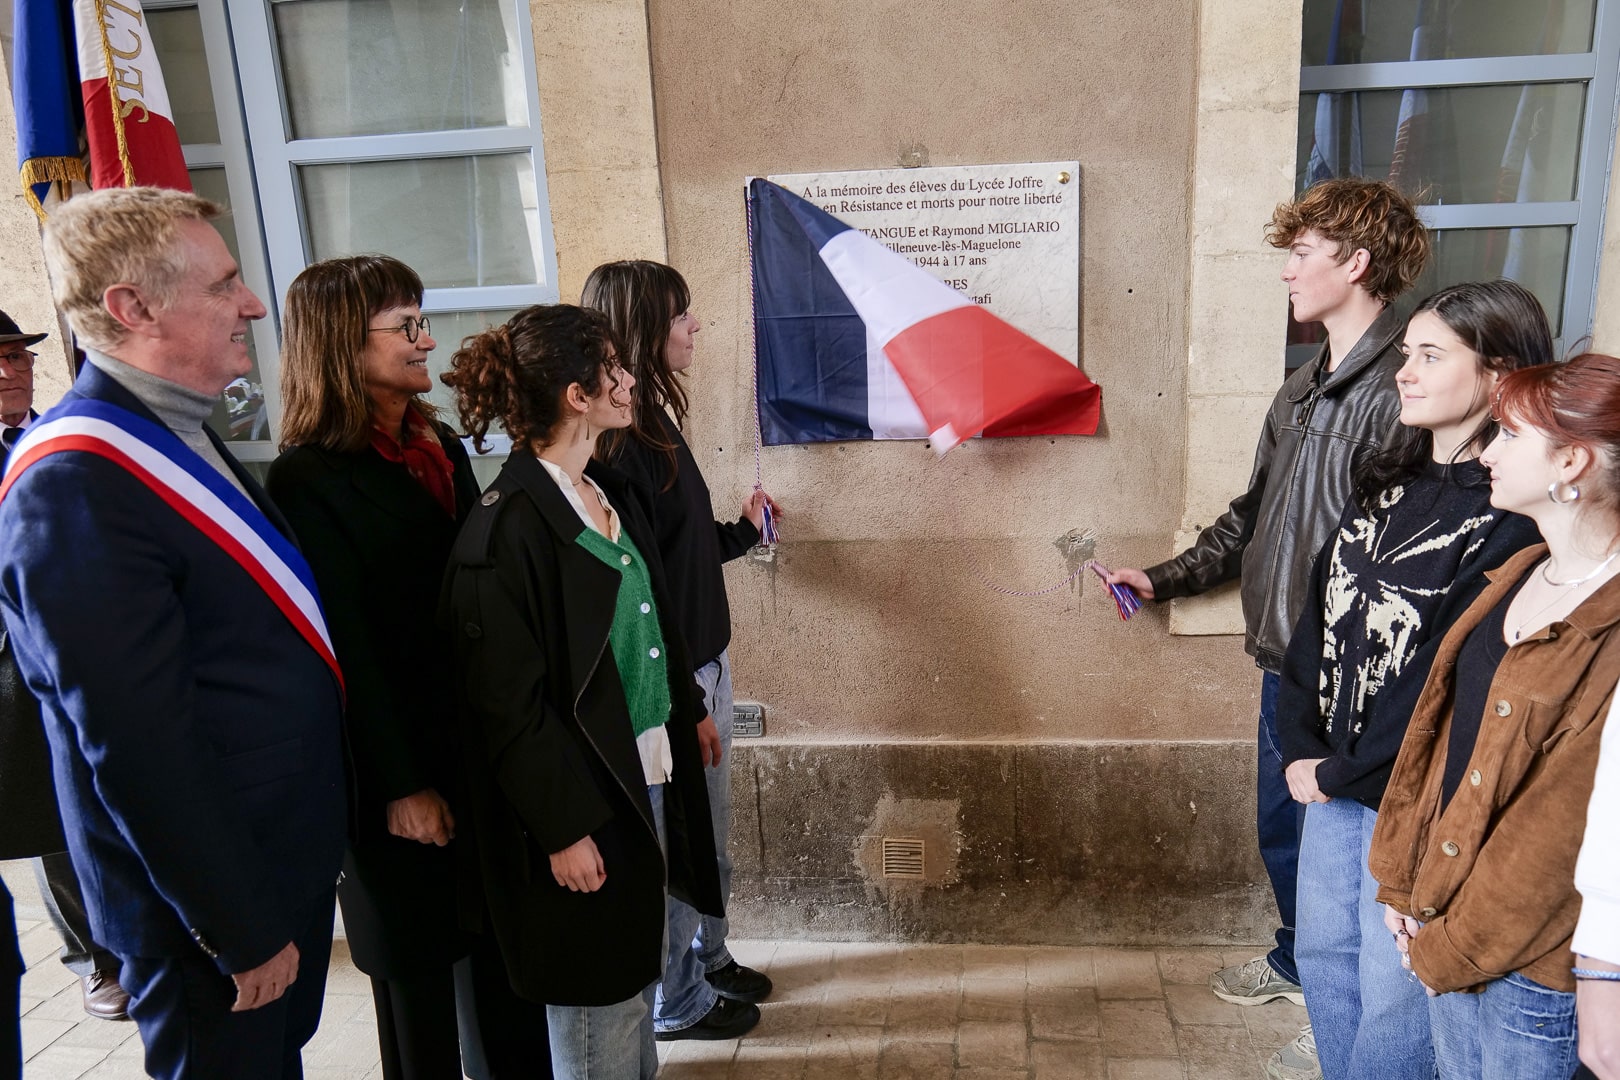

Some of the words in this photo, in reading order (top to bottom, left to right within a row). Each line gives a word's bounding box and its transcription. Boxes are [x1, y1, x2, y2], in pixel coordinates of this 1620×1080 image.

[803, 187, 812, 198] A
[817, 186, 827, 198] la
[831, 184, 882, 197] mémoire
[886, 183, 906, 195] des
[910, 181, 946, 193] élèves
[950, 180, 965, 191] du
[969, 178, 1005, 193] Lycée
[1008, 176, 1043, 189] Joffre
[823, 203, 837, 214] en
[841, 200, 903, 213] Résistance
[907, 200, 917, 209] et
[921, 197, 955, 209] morts
[958, 197, 986, 211] pour
[989, 195, 1020, 206] notre
[1024, 192, 1062, 205] liberté
[860, 226, 917, 239] TANGUE
[919, 228, 929, 237] et
[932, 224, 984, 239] Raymond
[988, 221, 1060, 234] MIGLIARIO
[885, 238, 1021, 254] illeneuve-lès-Maguelone
[915, 256, 939, 267] 1944
[943, 256, 949, 266] à
[954, 255, 965, 266] 17
[969, 256, 987, 266] ans
[969, 293, 992, 304] tafi
